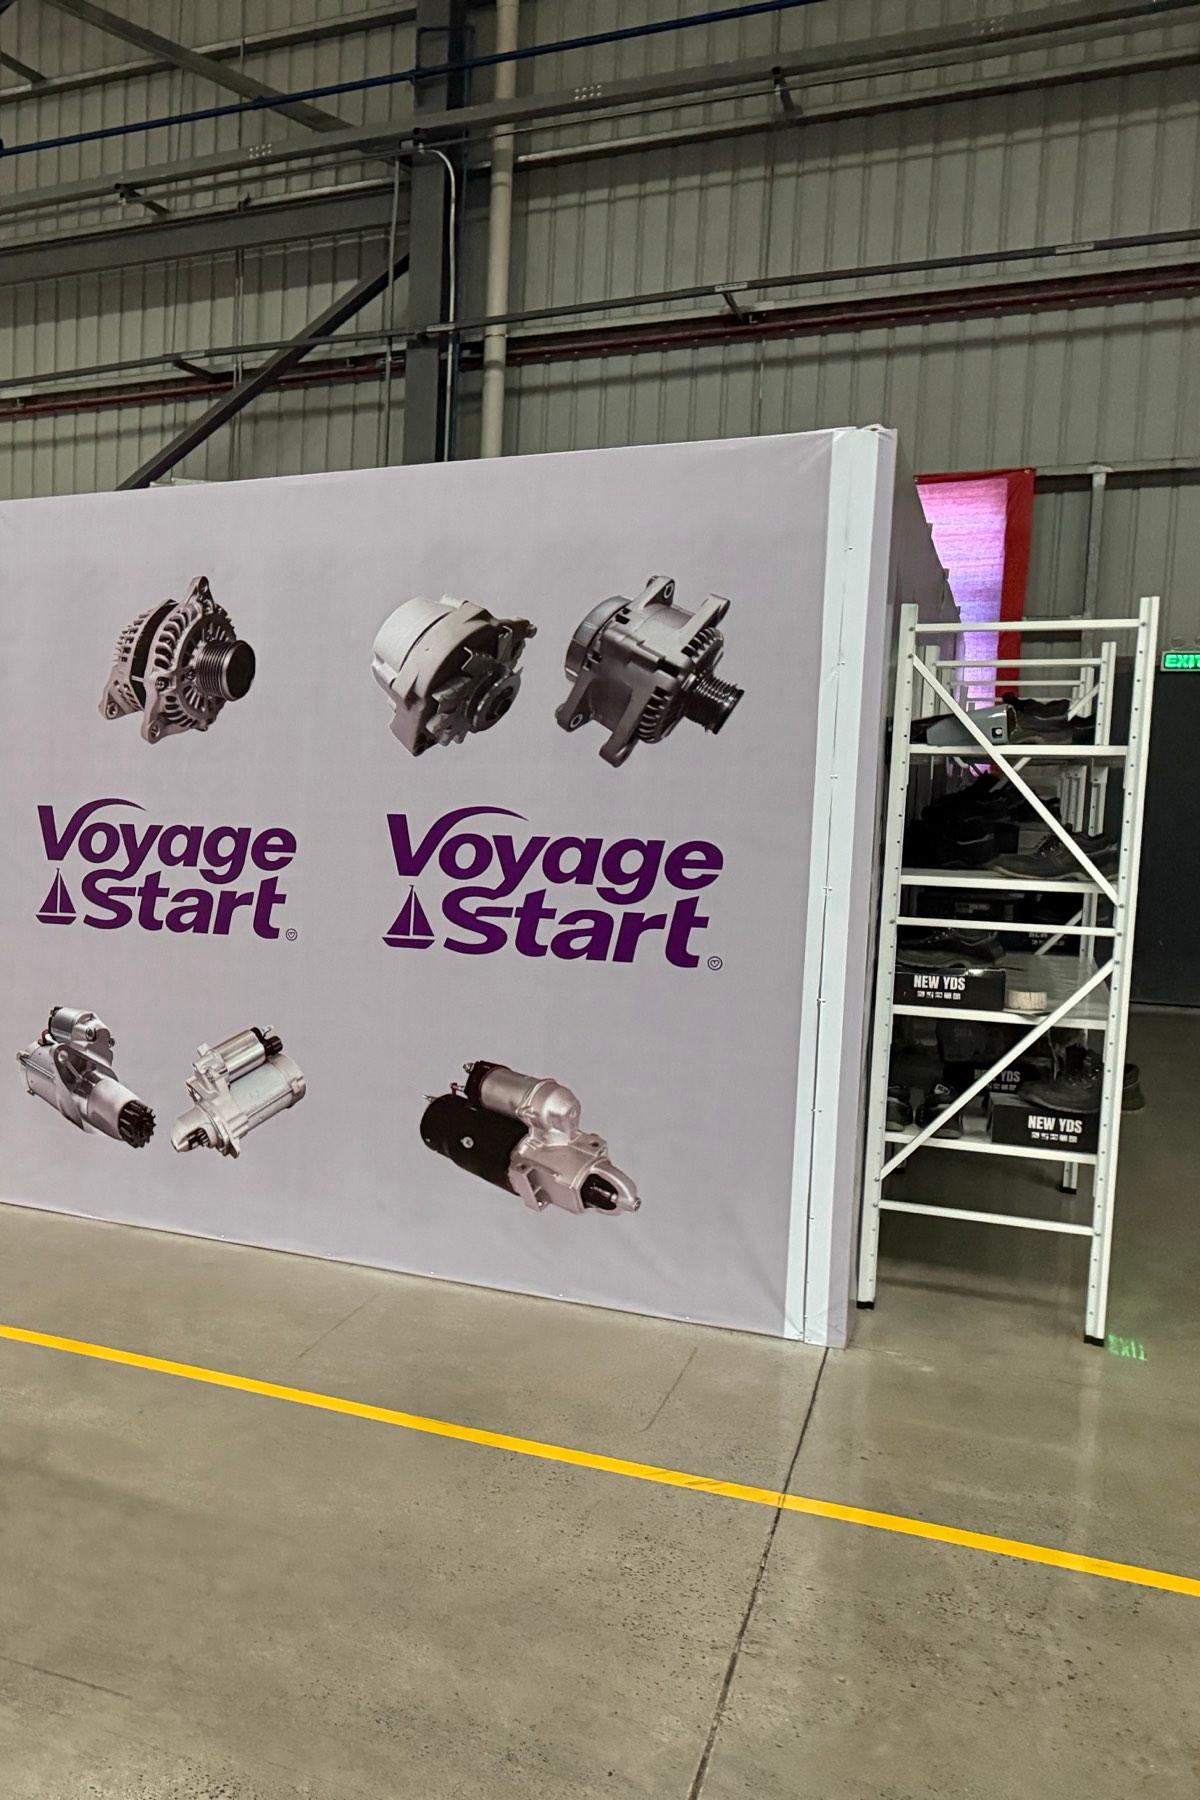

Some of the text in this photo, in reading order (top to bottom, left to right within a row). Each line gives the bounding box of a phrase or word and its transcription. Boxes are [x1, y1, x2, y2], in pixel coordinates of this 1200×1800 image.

[37, 798, 297, 884] Voyage
[386, 806, 724, 905] Voyage
[81, 868, 287, 939] Start
[441, 886, 710, 968] Start
[913, 974, 966, 991] NEW YDS
[1027, 1115, 1083, 1134] NEW YDS
